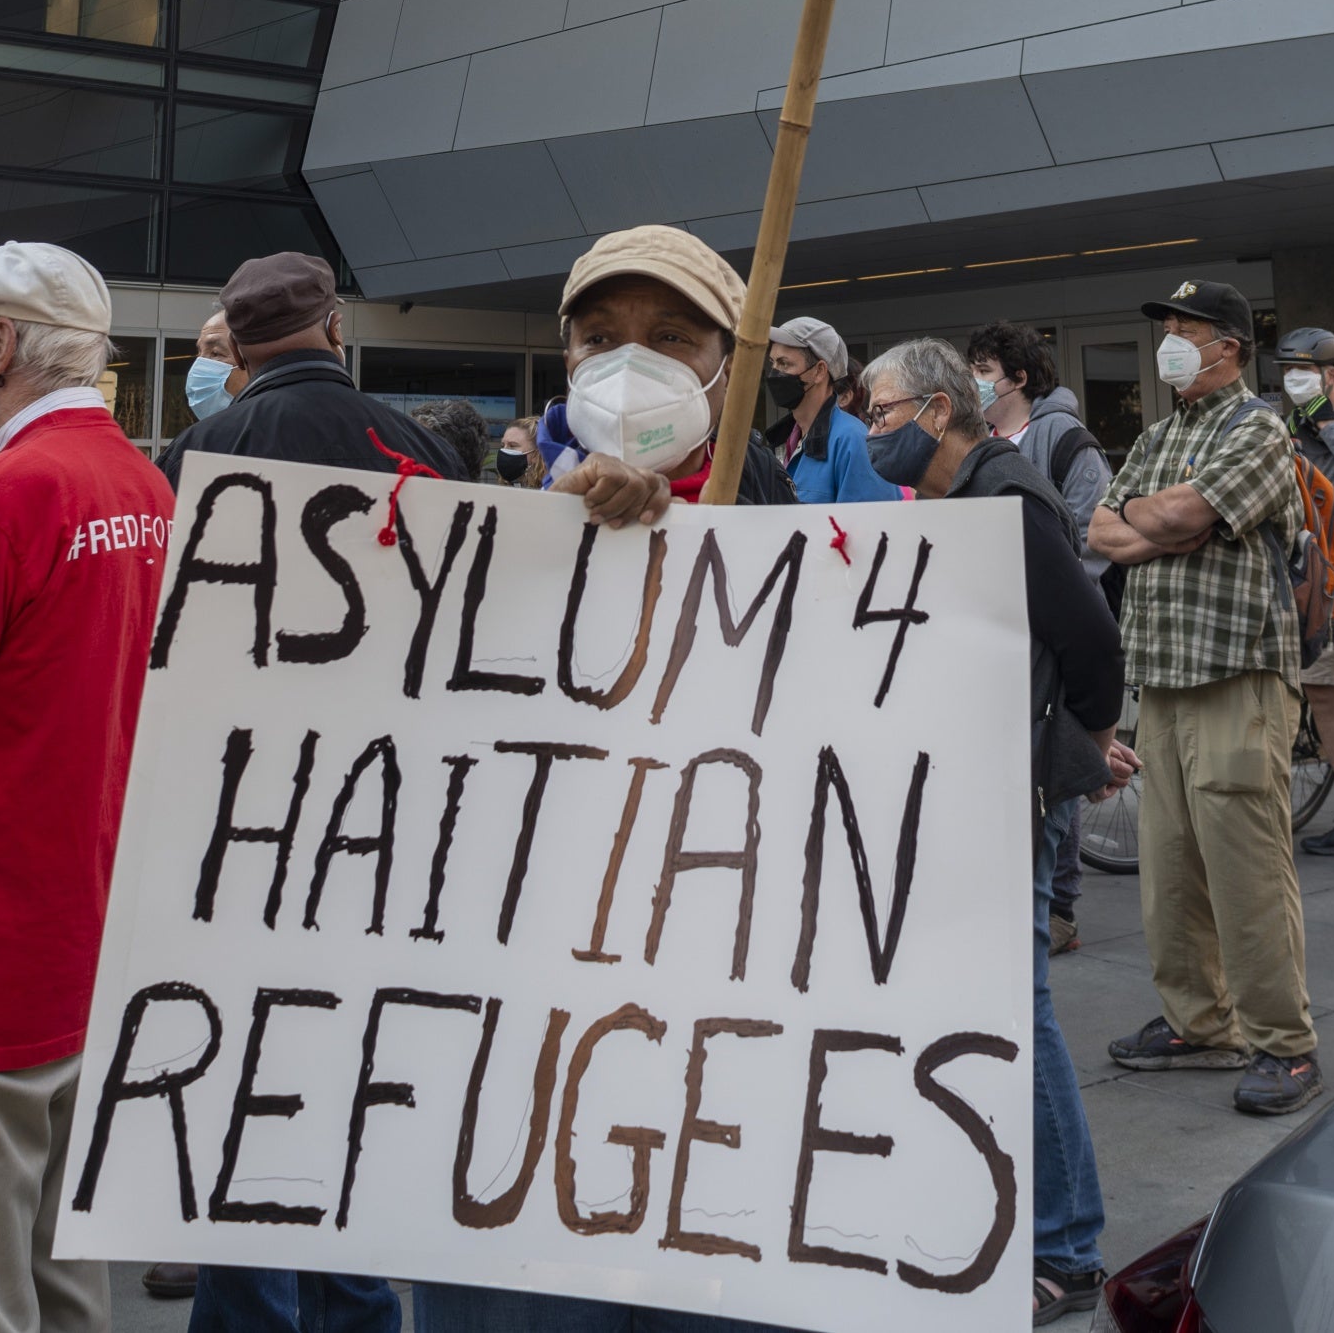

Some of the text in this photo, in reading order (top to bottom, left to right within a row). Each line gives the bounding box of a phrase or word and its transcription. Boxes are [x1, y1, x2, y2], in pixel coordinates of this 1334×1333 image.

[149, 472, 933, 737] ASYLUM 4
[192, 726, 930, 994] HAITIAN
[72, 979, 1021, 1297] REFUGEES
